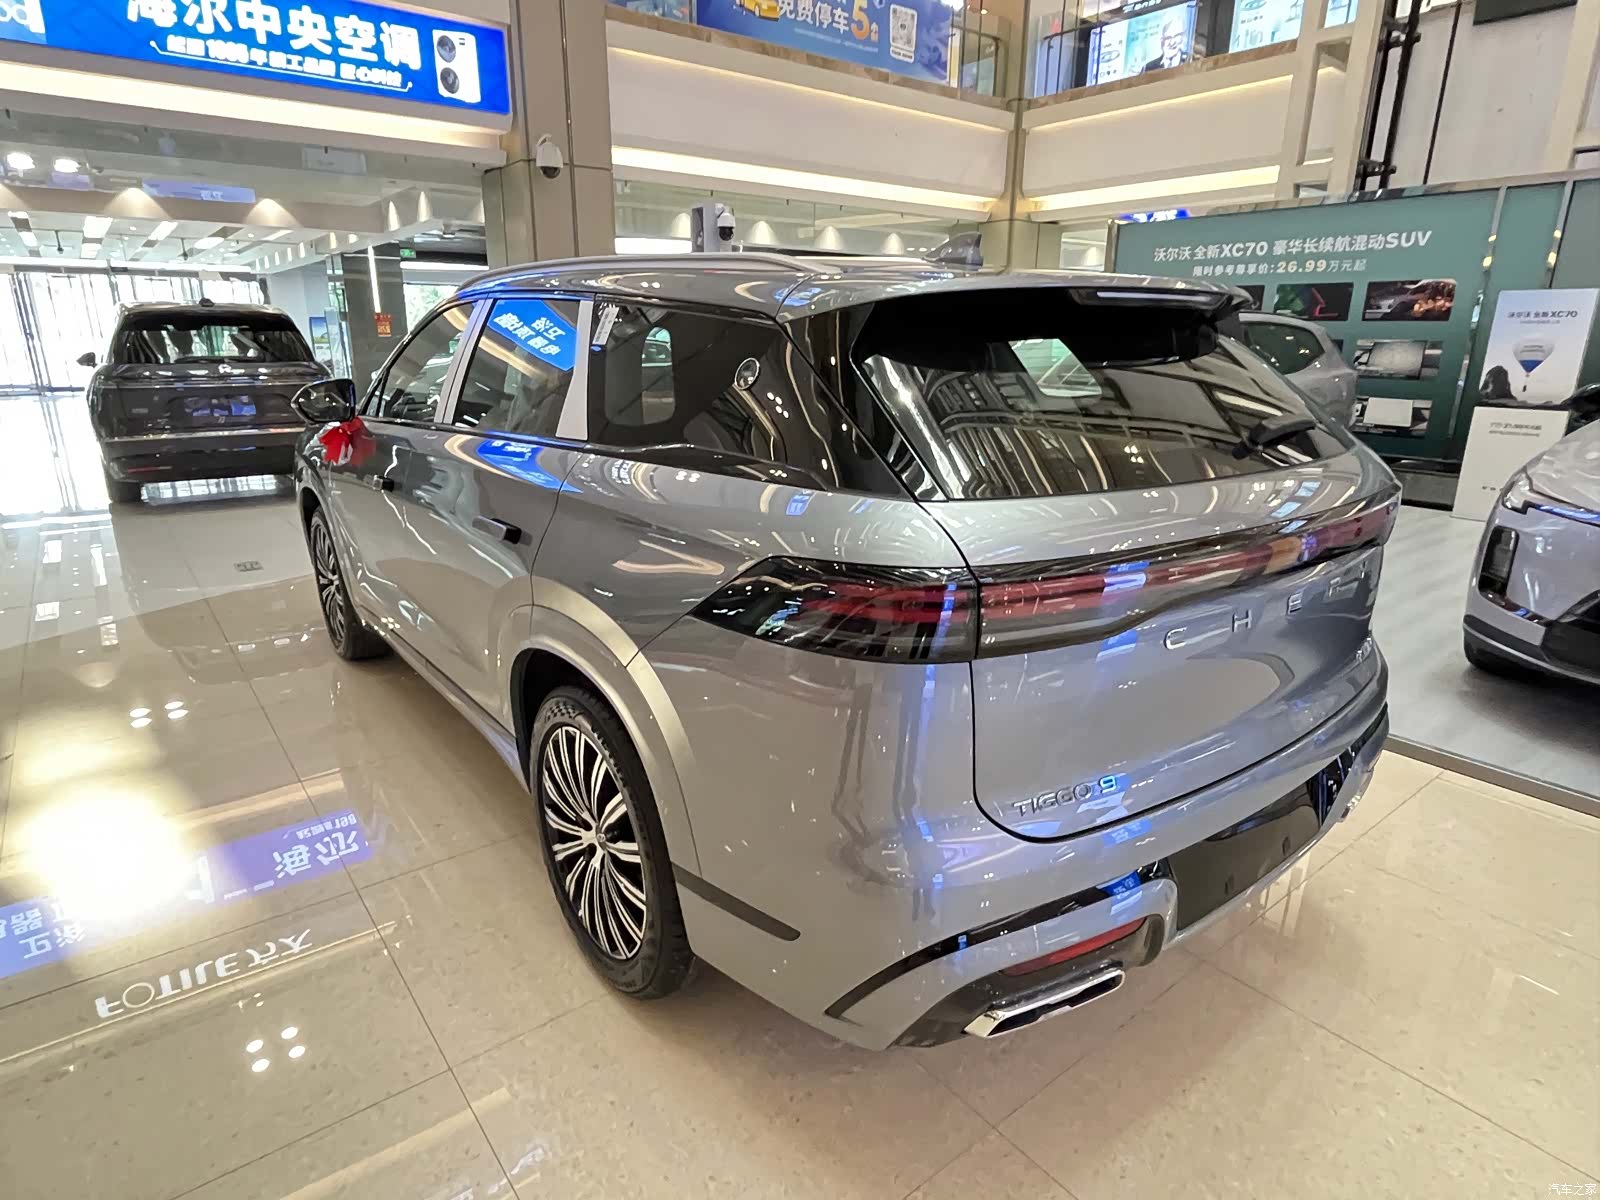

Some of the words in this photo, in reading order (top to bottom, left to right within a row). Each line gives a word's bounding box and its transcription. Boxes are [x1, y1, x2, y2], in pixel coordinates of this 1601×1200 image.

[128, 0, 421, 71] 海尔中央空调
[1012, 783, 1092, 817] TIGGO
[1098, 775, 1118, 794] 9
